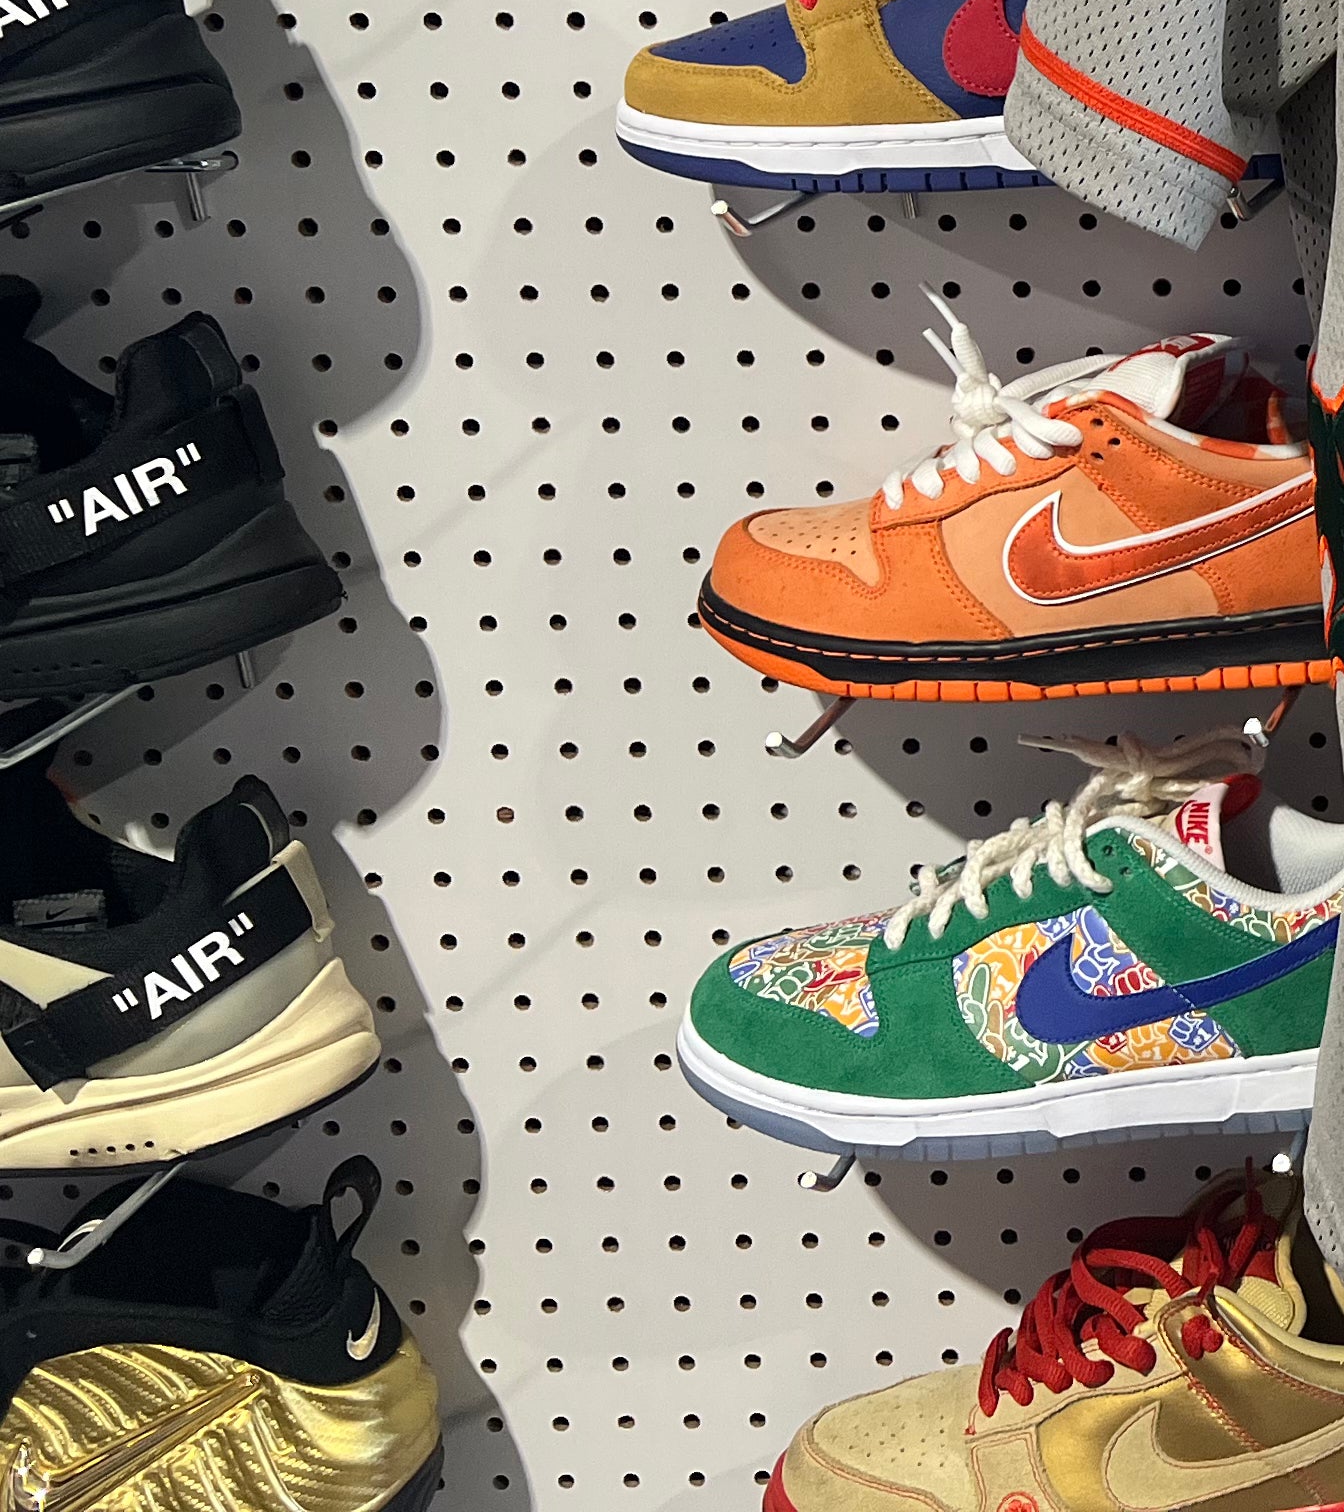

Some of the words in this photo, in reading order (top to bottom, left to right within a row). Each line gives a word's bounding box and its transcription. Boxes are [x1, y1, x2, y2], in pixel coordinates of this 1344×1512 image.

[47, 442, 202, 537] "AIR"
[1184, 802, 1211, 845] NIKE
[111, 912, 254, 1020] "AIR"
